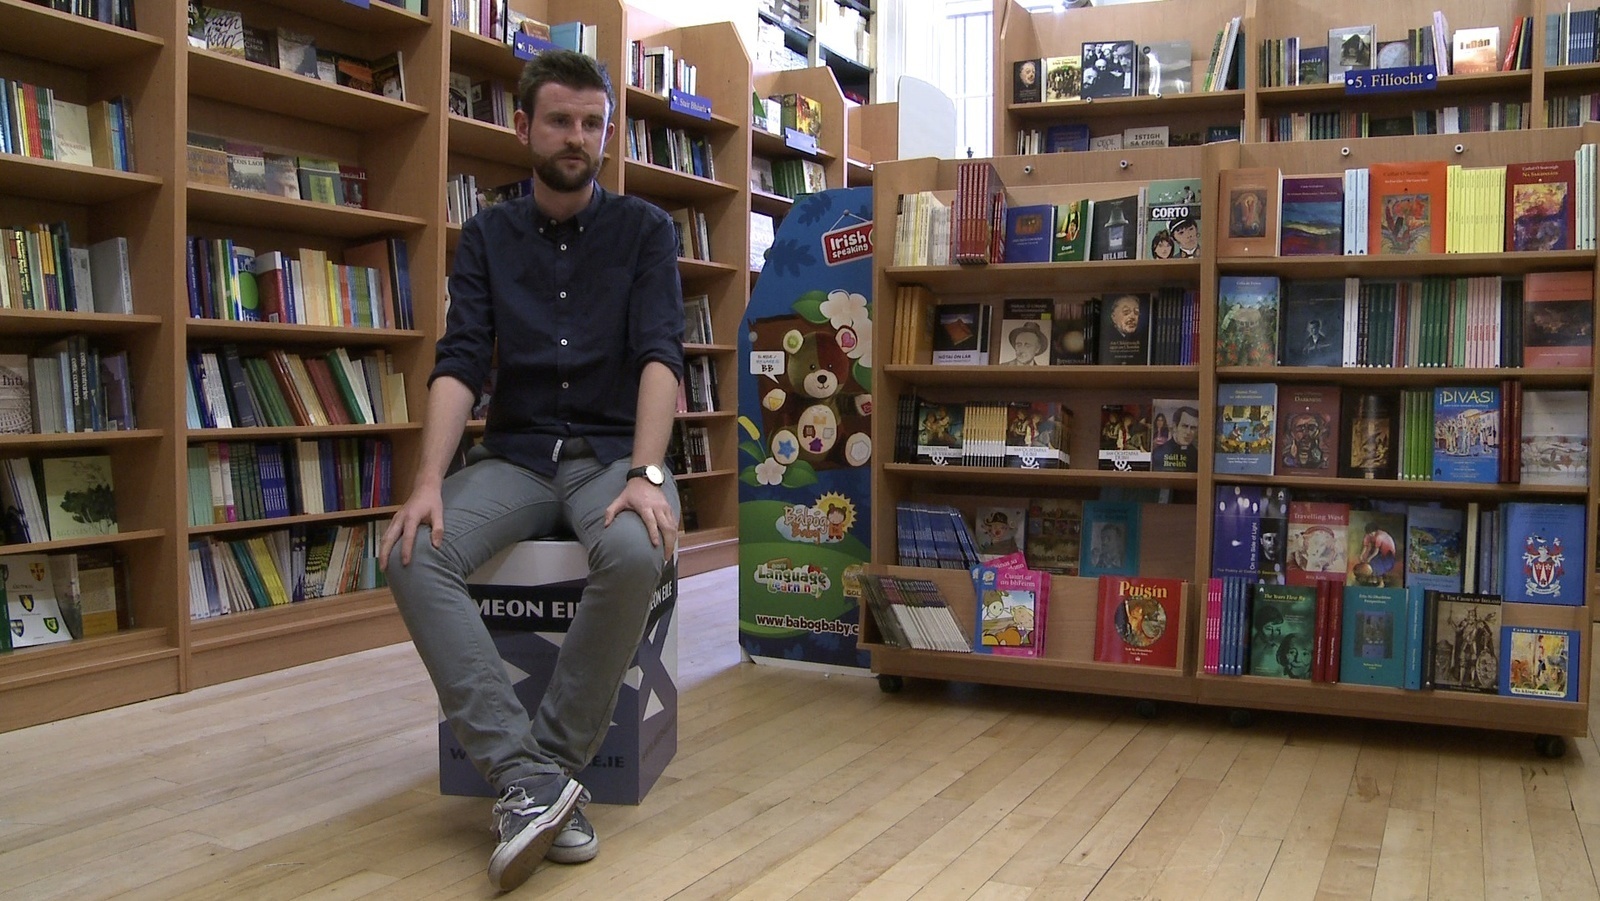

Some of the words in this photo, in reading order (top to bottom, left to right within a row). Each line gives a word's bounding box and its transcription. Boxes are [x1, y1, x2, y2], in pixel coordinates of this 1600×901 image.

[1355, 76, 1367, 88] 5.
[1371, 72, 1424, 87] Filíocht
[1152, 206, 1189, 218] CORTO
[830, 231, 867, 249] Irish
[832, 243, 869, 260] speaking
[761, 364, 774, 372] BB
[1439, 389, 1494, 405] ¡DIVAS!
[1163, 453, 1177, 461] Súil
[1294, 512, 1326, 522] Travelling
[758, 564, 827, 585] Language
[767, 578, 822, 598] Learning
[1119, 580, 1168, 598] Puisín
[650, 588, 662, 610] EON
[757, 614, 860, 636] www.babogbaby.c
